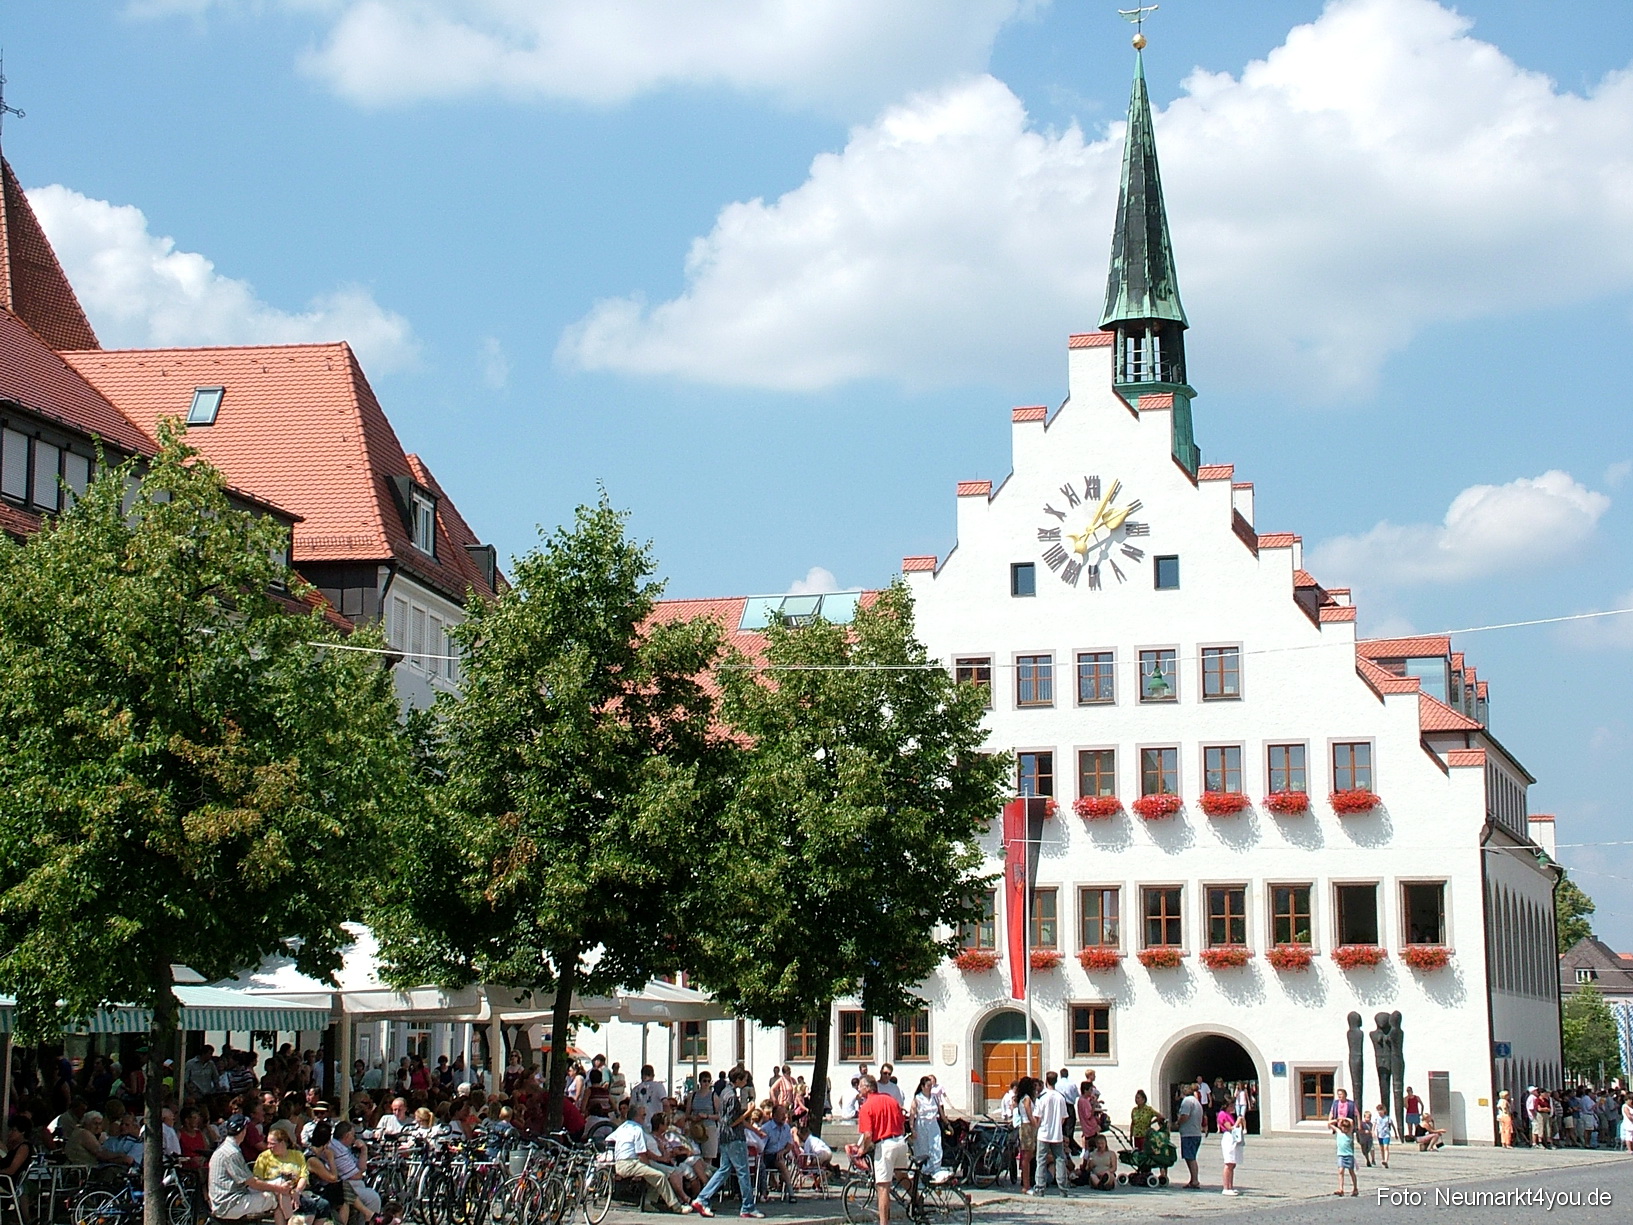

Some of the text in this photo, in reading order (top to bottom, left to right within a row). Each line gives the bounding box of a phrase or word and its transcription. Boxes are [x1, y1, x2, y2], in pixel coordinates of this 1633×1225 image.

[1060, 482, 1081, 509] XI
[1084, 475, 1100, 501] XII
[1043, 503, 1067, 522] X
[1037, 527, 1061, 542] IX
